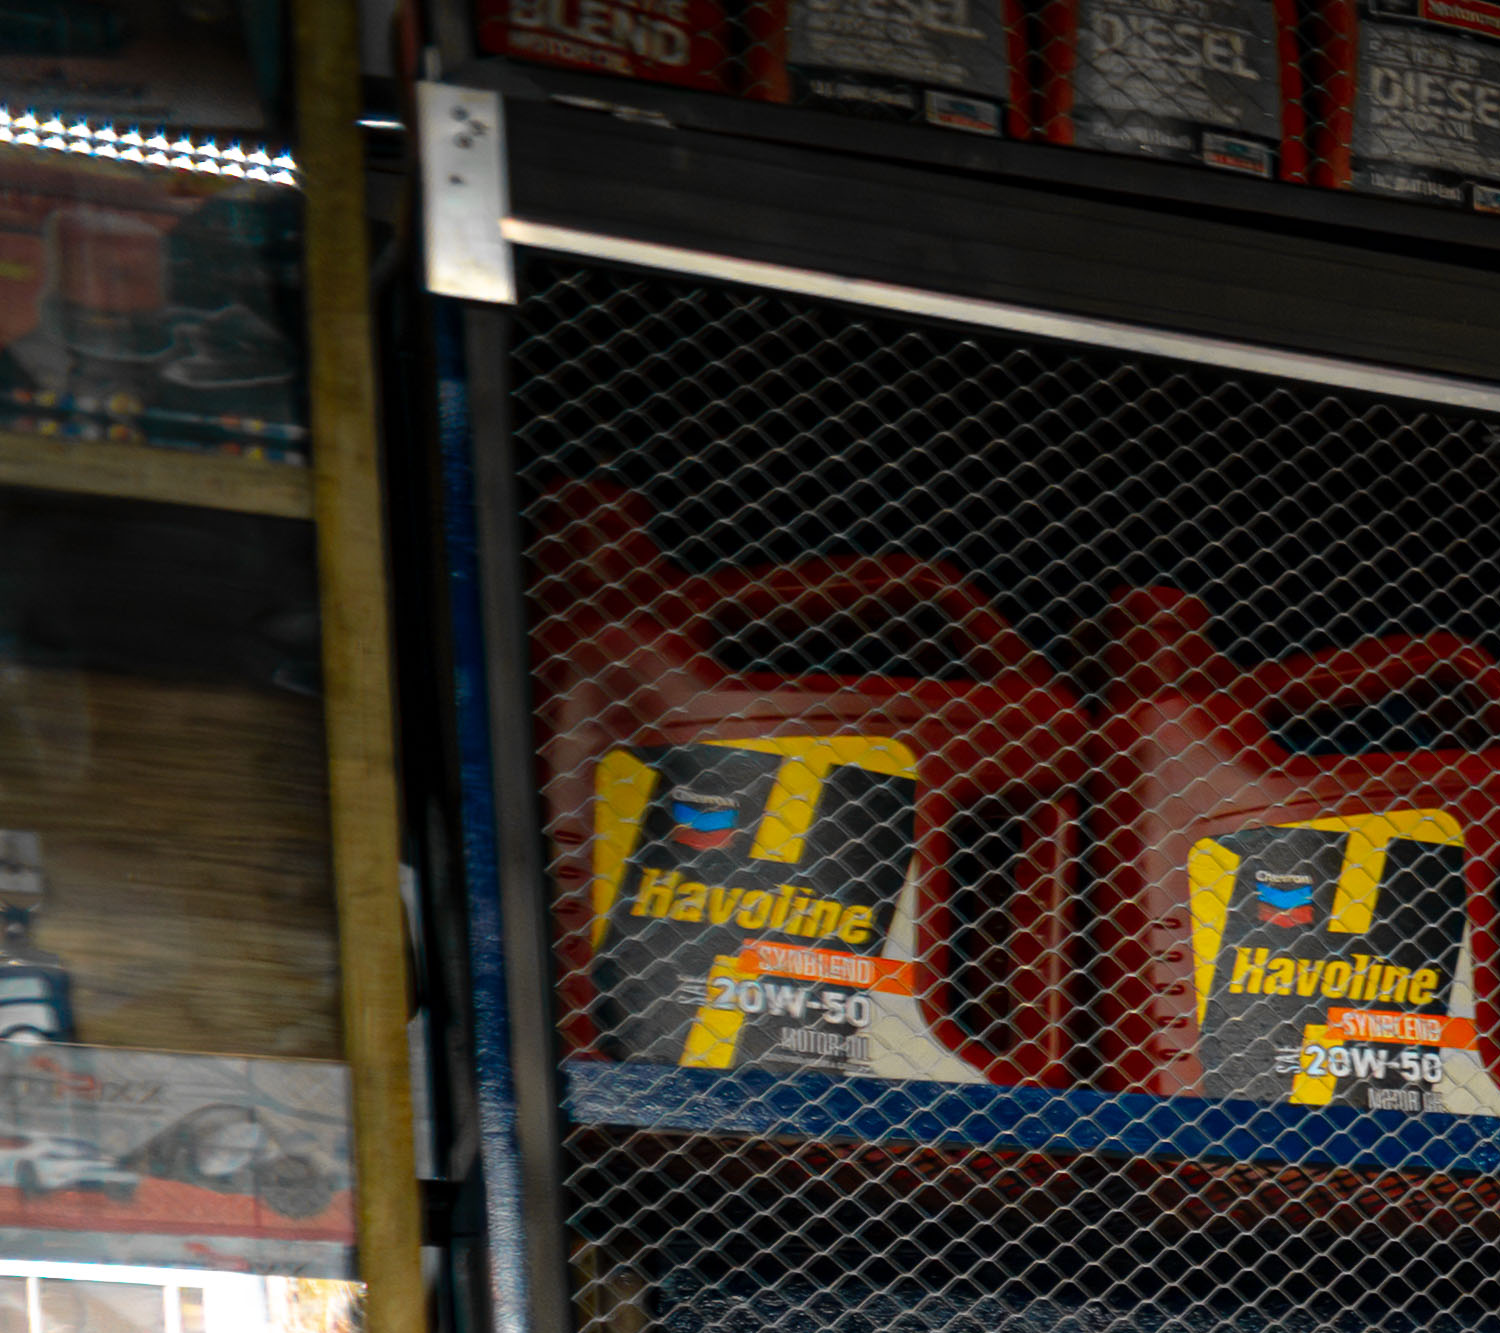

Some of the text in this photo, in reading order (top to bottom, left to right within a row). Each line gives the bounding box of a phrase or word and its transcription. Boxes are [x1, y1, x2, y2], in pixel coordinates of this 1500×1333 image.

[630, 866, 875, 945] Havoline
[758, 948, 876, 985] SYNBLEND
[1228, 946, 1442, 1007] Havoline
[709, 976, 871, 1028] 20W-50
[1305, 1044, 1443, 1083] 20W-50
